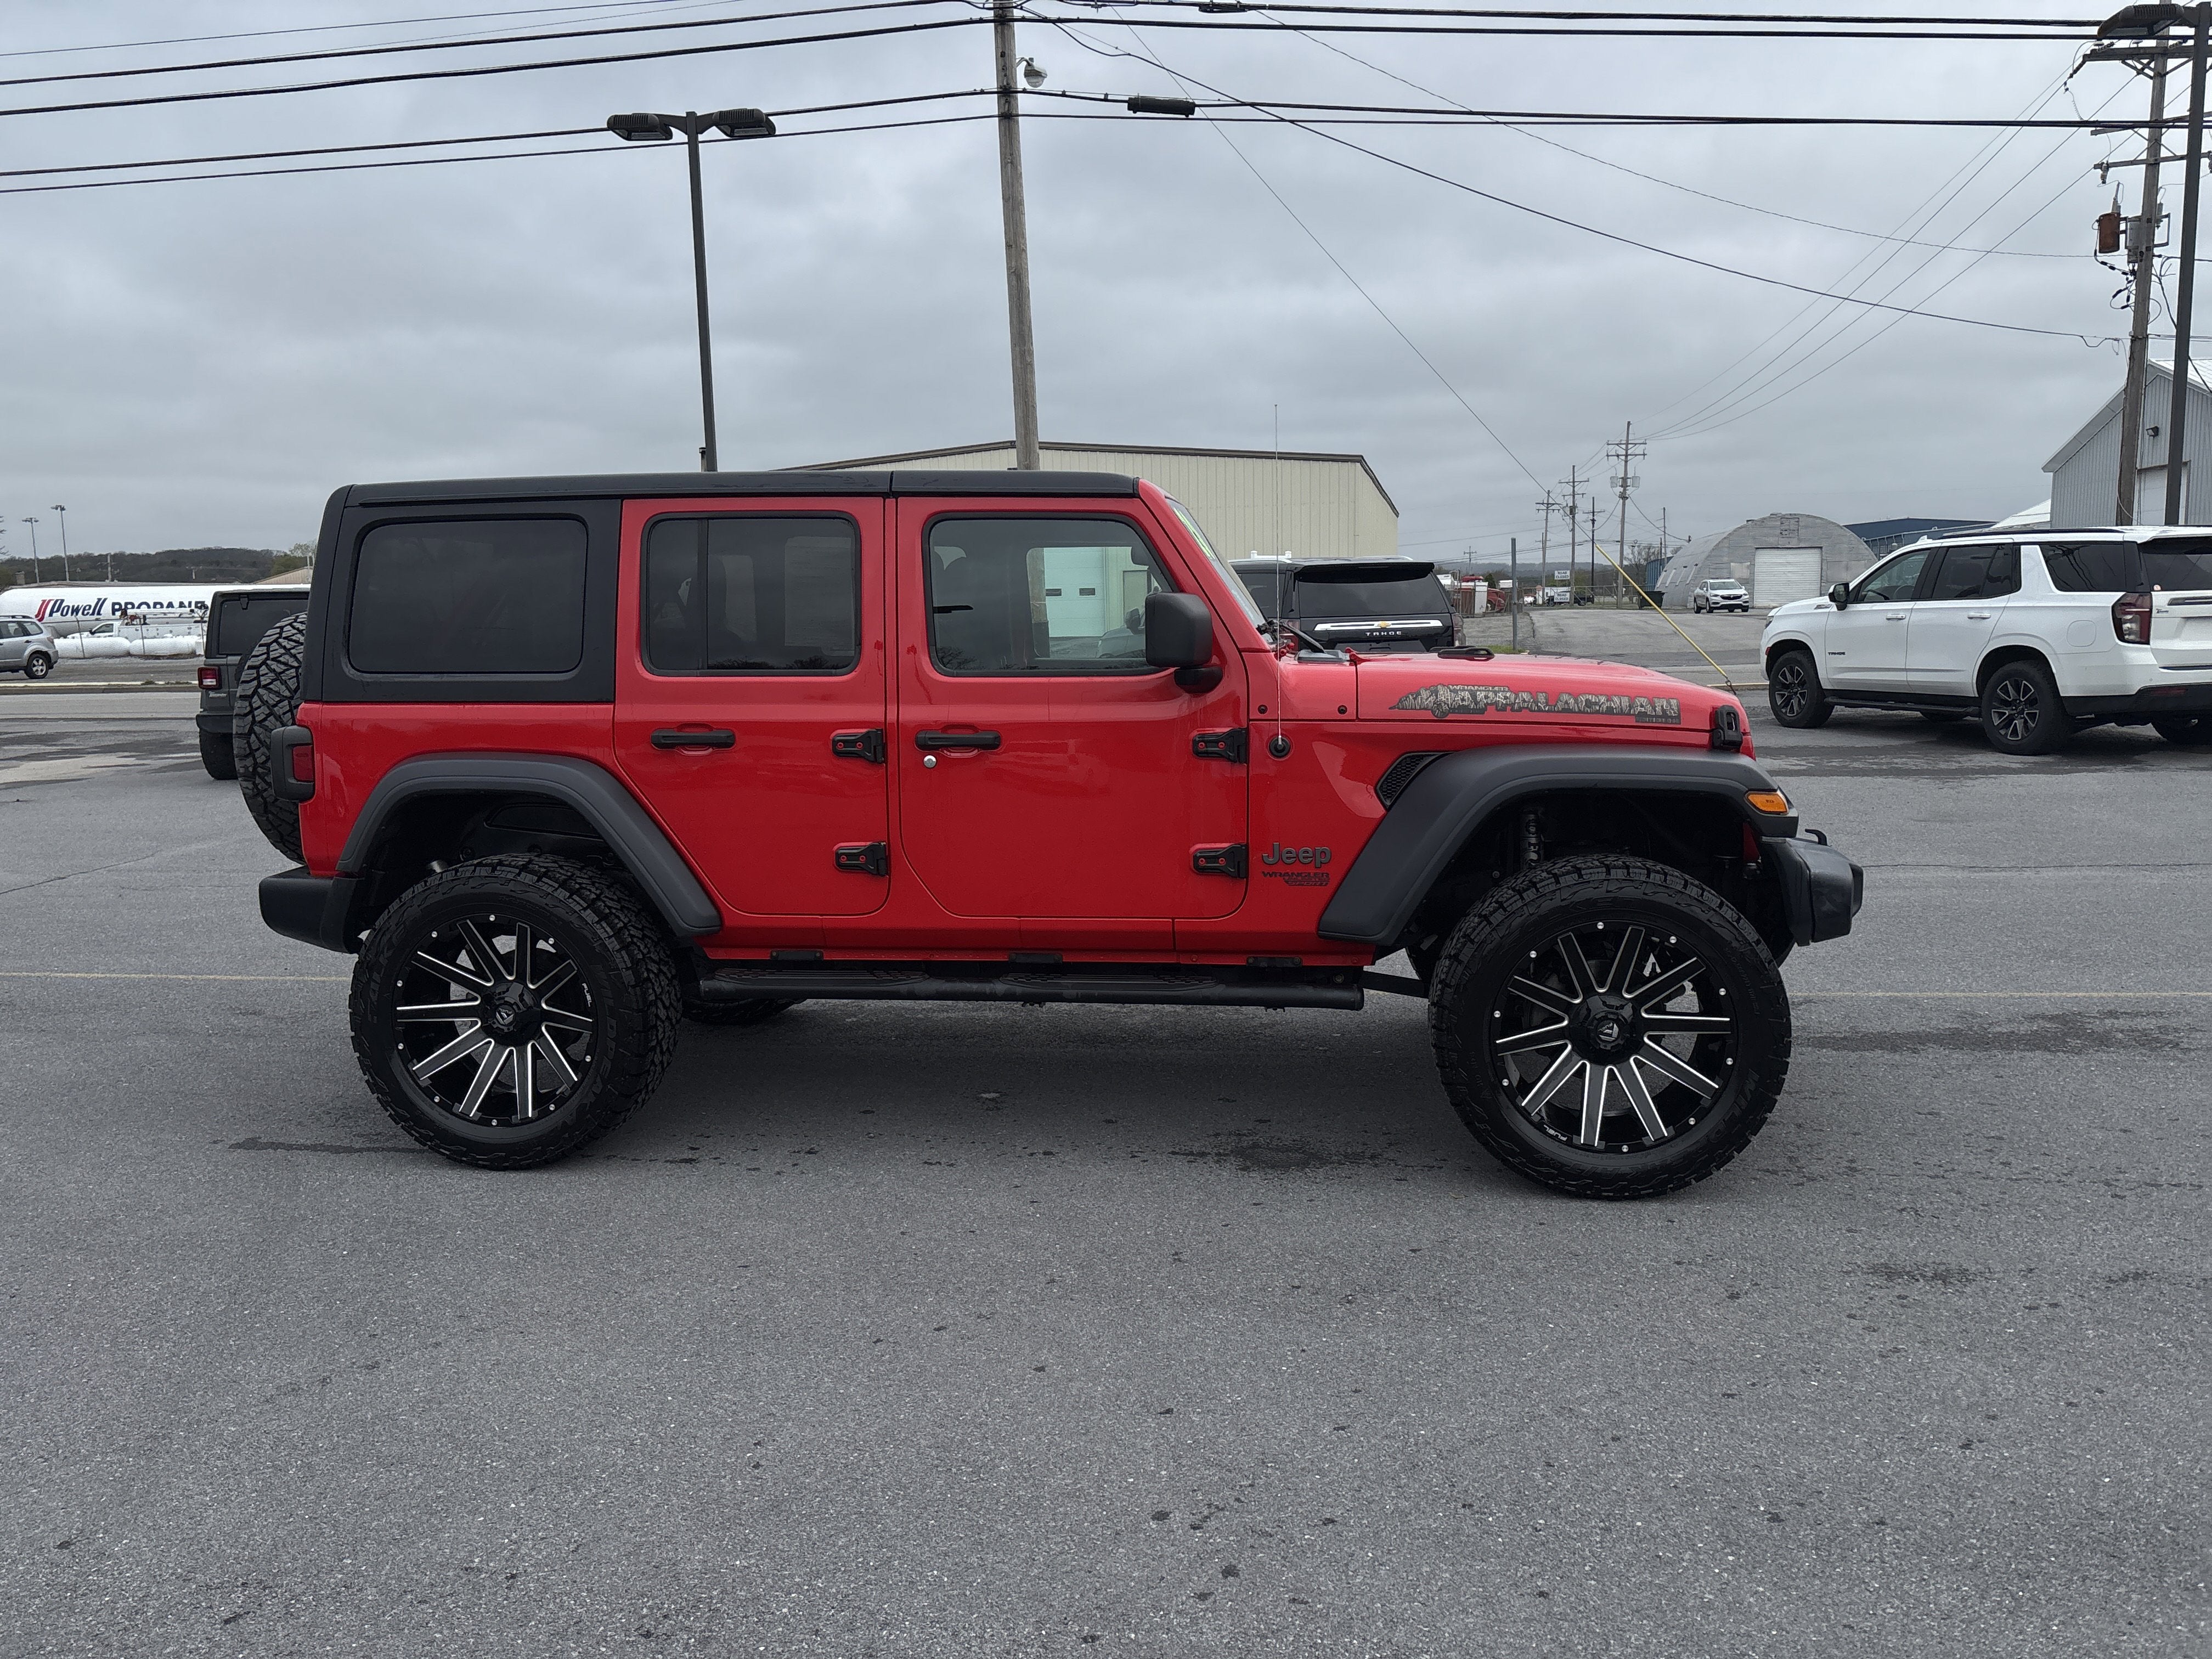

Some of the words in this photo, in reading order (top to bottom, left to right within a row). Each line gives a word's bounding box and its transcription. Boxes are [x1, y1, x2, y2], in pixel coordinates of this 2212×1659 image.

[48, 597, 108, 617] Powell
[1262, 842, 1331, 868] Jeep
[582, 983, 592, 1007] FUEL
[1543, 1125, 1568, 1141] FUEL
